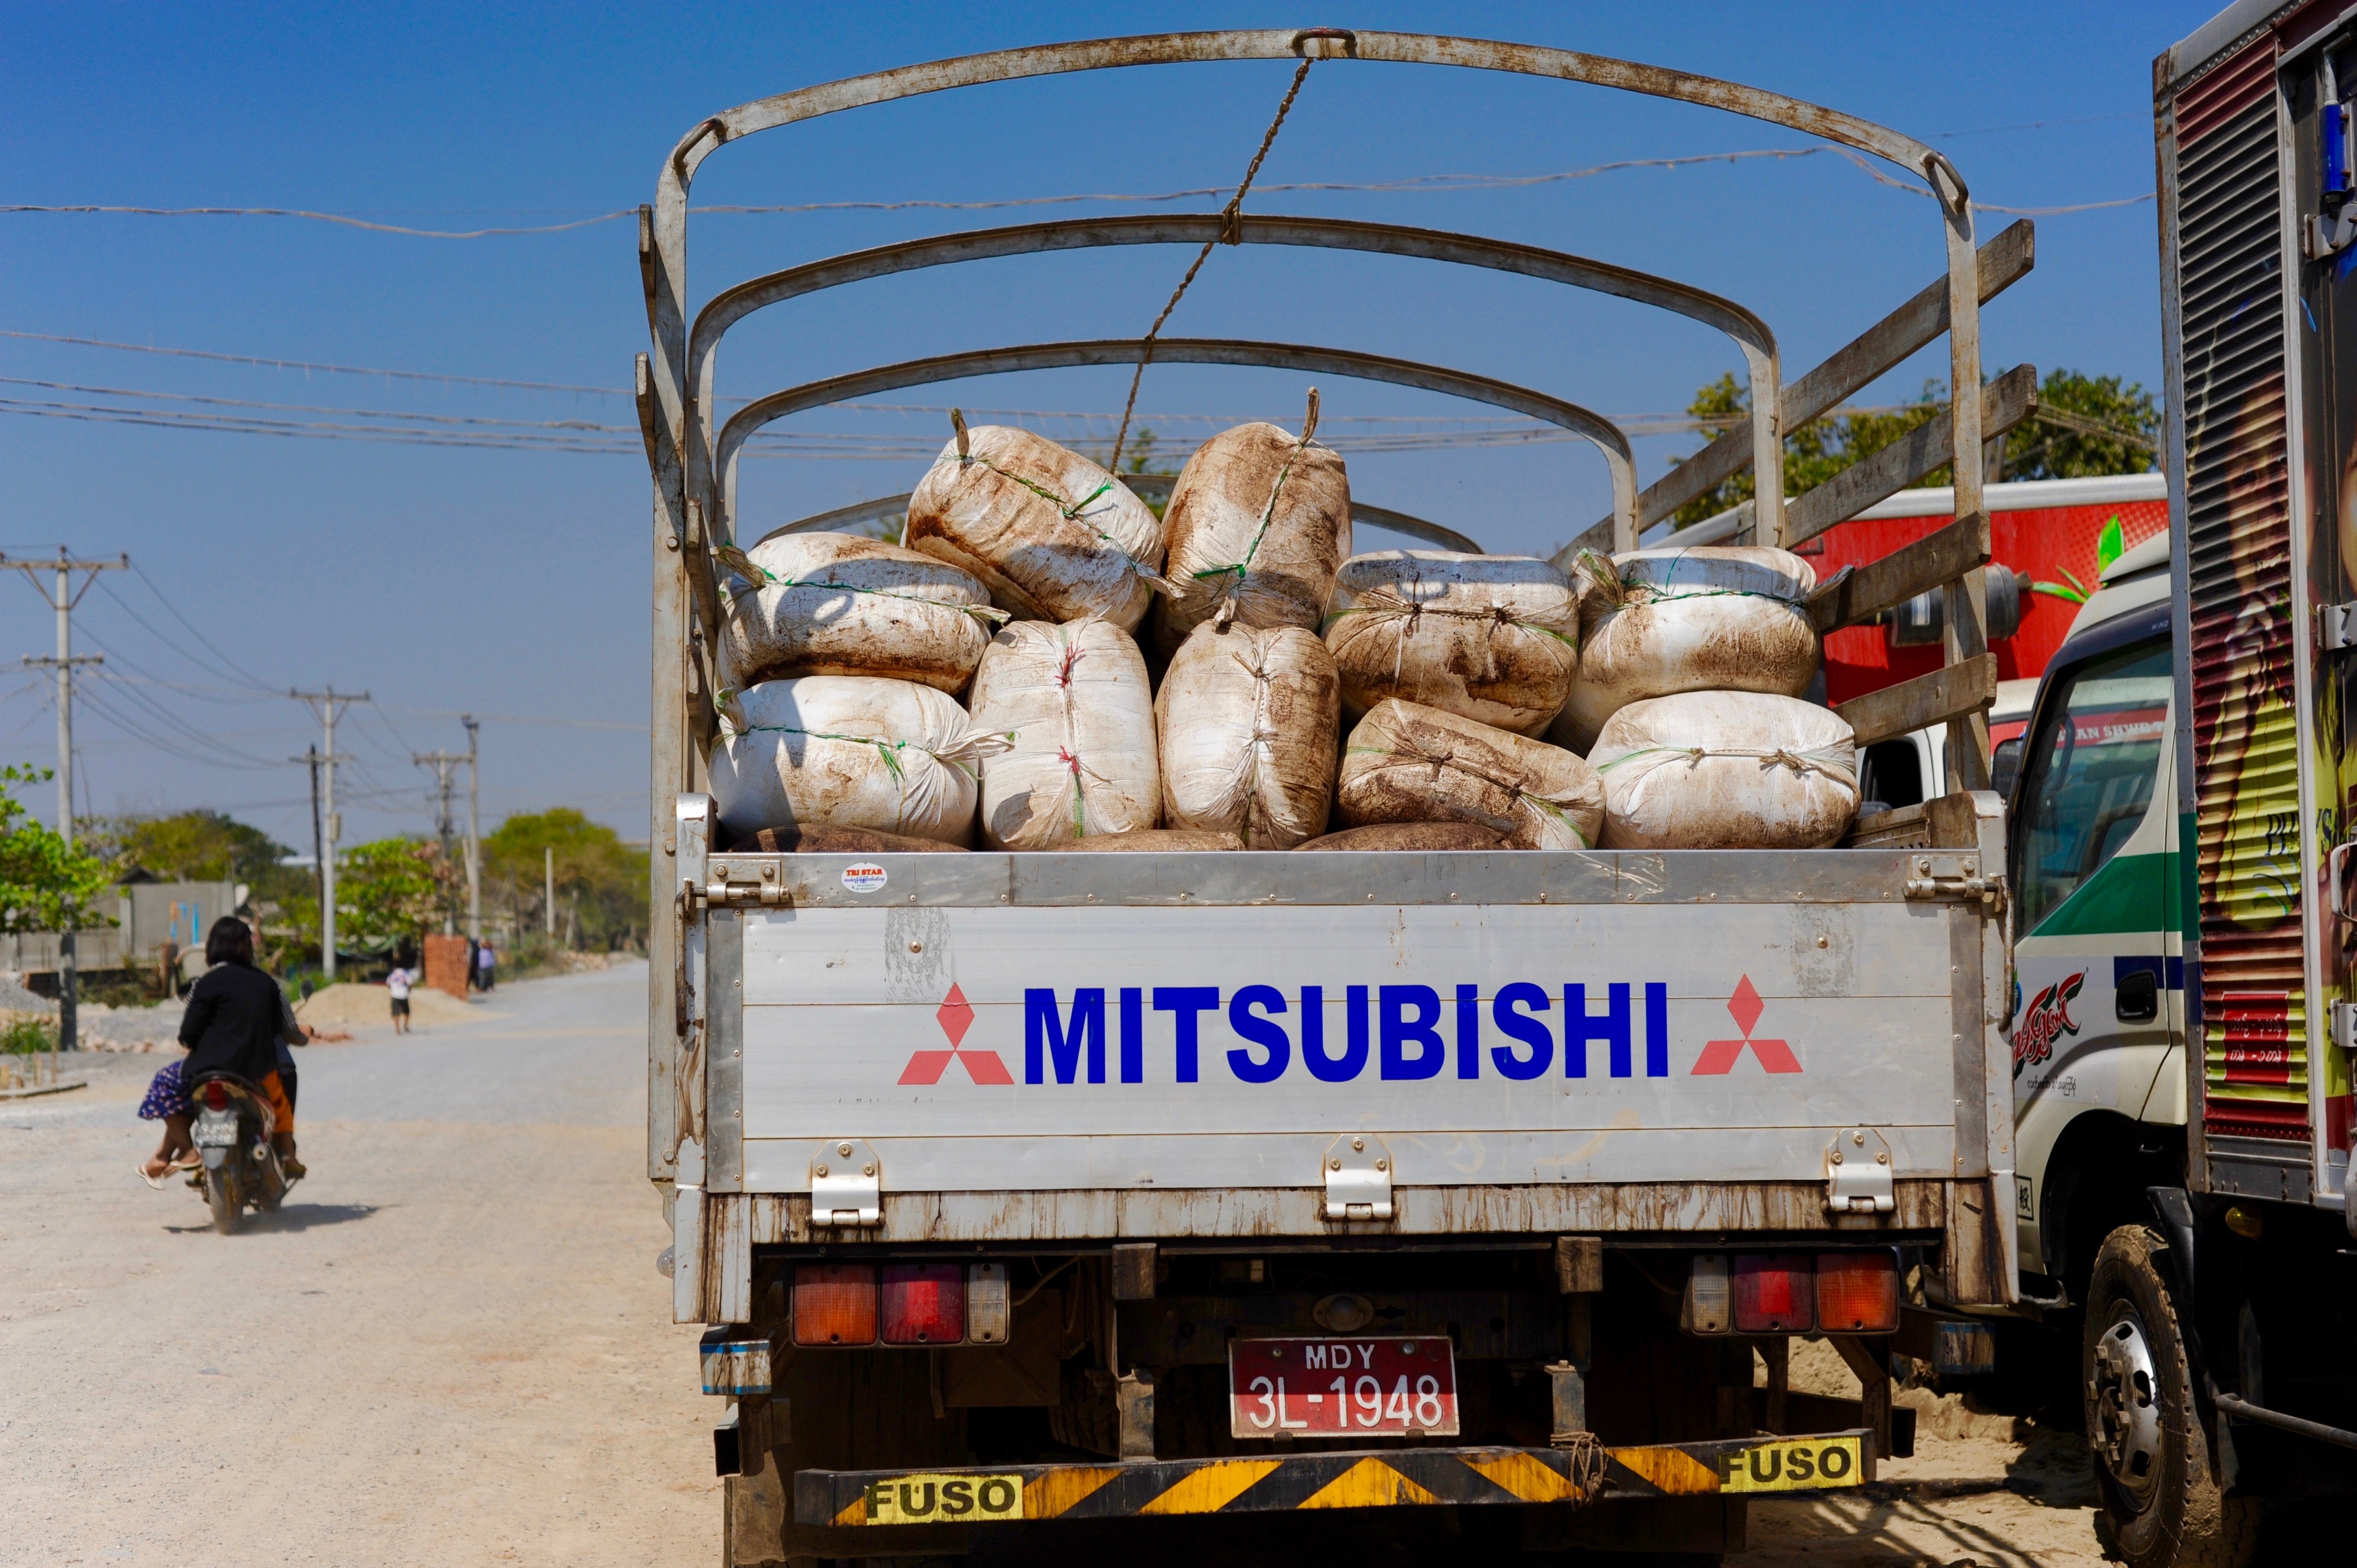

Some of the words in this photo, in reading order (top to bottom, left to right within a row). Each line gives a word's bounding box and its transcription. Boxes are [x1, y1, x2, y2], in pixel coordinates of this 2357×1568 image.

[2152, 620, 2169, 631] HINO
[1025, 982, 1669, 1085] MITSUBISHI
[1305, 1344, 1376, 1370] MDY
[1249, 1374, 1443, 1430] 3L-1948
[1719, 1446, 1852, 1485] FUSO
[865, 1479, 1016, 1519] FUSO
